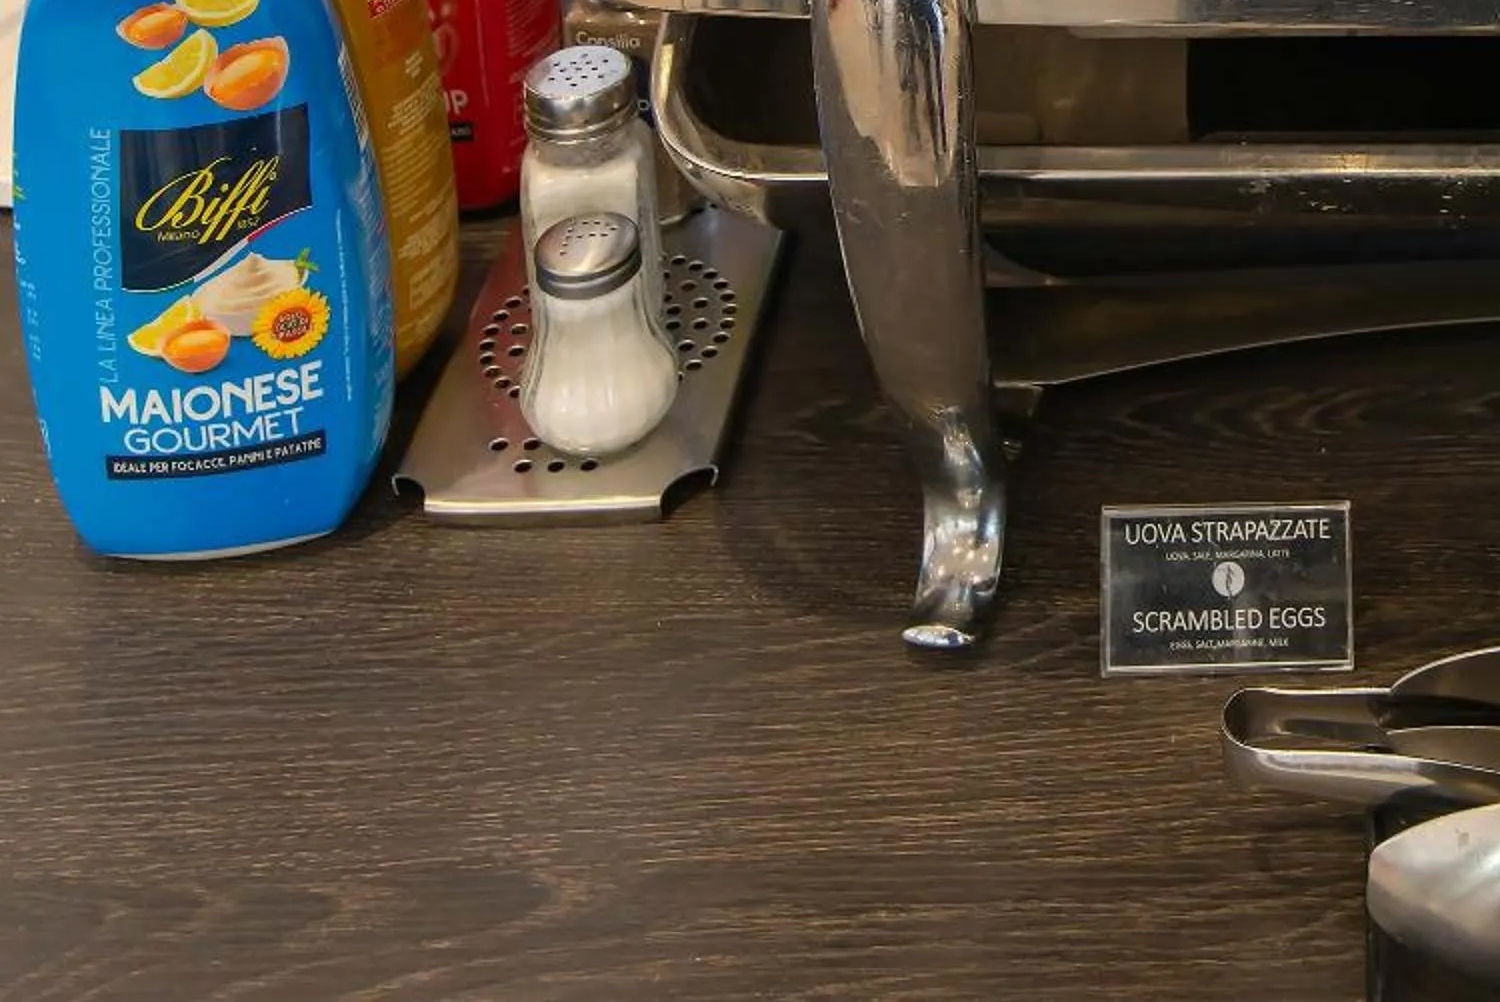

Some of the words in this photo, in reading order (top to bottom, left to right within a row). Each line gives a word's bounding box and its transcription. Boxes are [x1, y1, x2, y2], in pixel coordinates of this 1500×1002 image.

[89, 128, 114, 291] PROFESSIONALE
[135, 155, 281, 245] Biffi
[94, 300, 116, 354] LINEA
[97, 360, 120, 384] LA
[99, 359, 324, 425] MAIONESE
[123, 406, 304, 454] GOURMET
[113, 460, 147, 474] IDEALE
[149, 459, 169, 473] PER
[1124, 522, 1187, 545] UOVA
[1191, 518, 1331, 543] STRAPAZZATE
[1133, 608, 1263, 634] SCRAMBLED
[1269, 607, 1326, 630] EGGS
